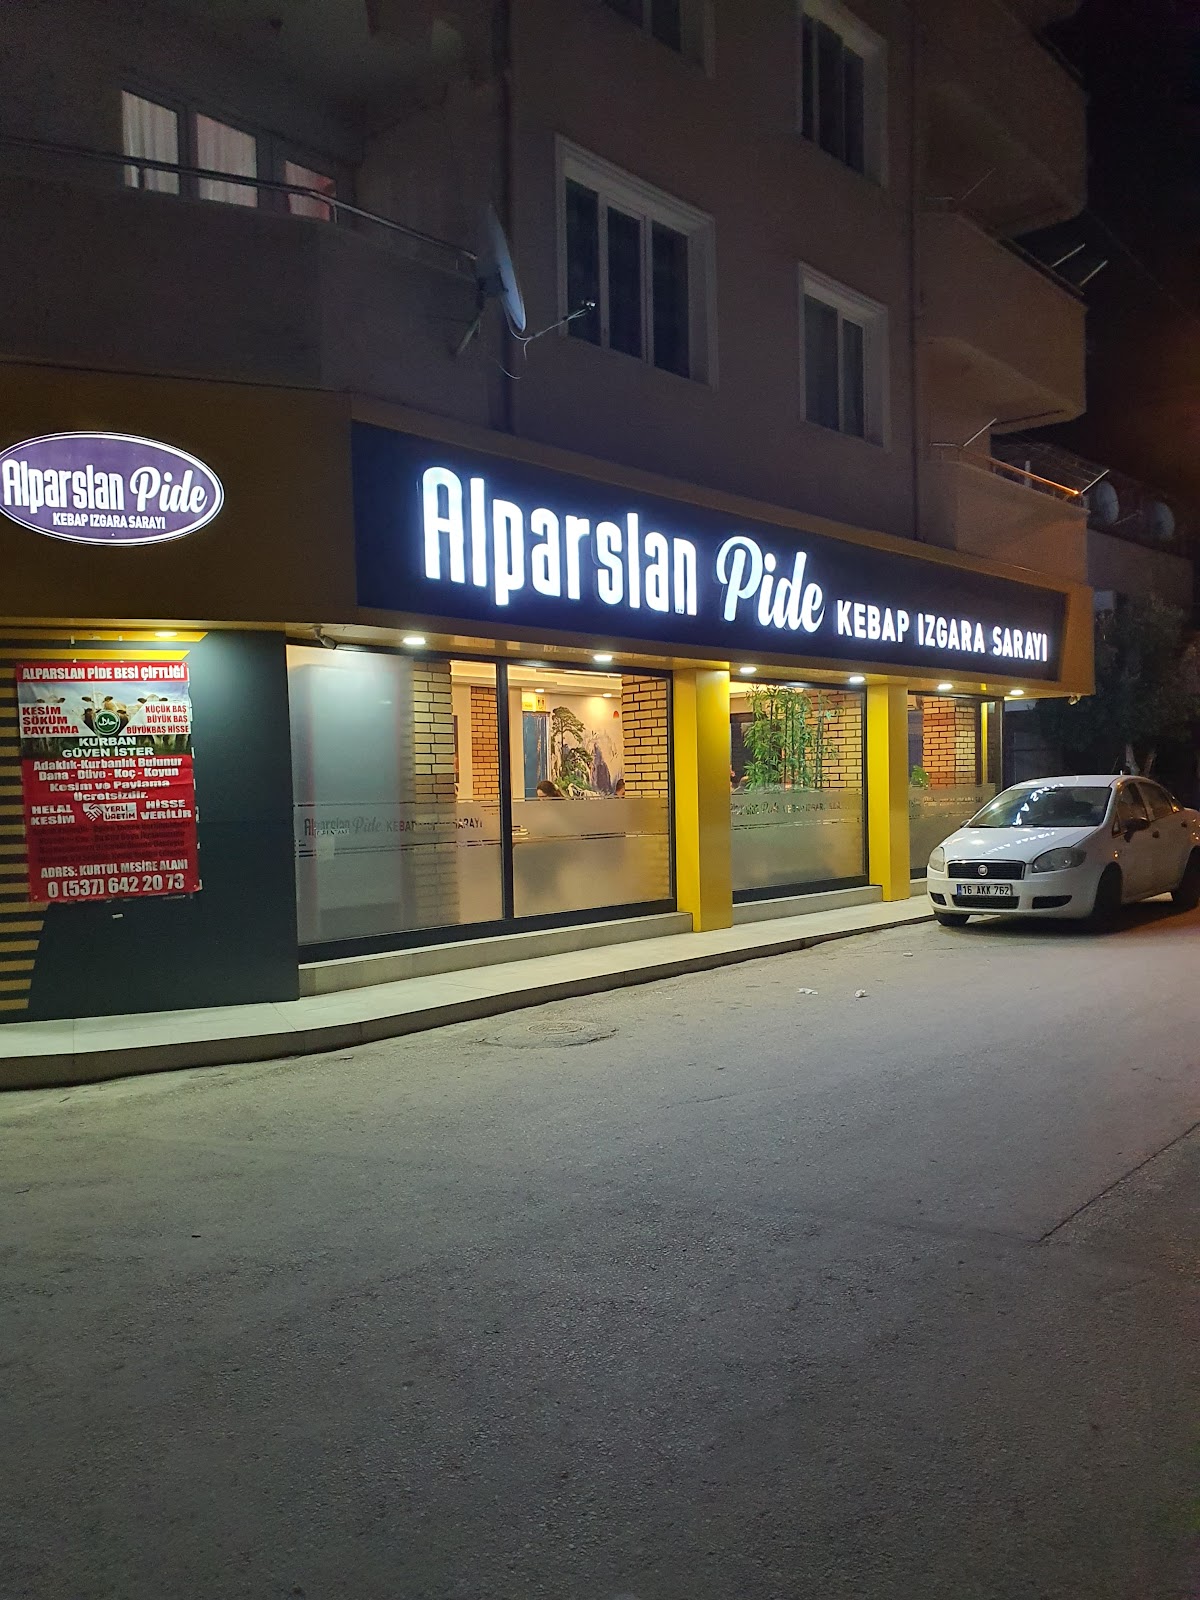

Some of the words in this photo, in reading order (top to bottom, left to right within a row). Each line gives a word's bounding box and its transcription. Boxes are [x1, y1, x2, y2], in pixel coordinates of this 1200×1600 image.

[2, 459, 125, 513] Alparslan
[130, 466, 208, 513] Pide
[53, 512, 88, 527] KEBAP
[89, 513, 128, 528] IZGARA
[129, 514, 166, 530] SARAYI
[422, 466, 698, 616] Alparslan
[716, 536, 824, 633] Pide
[837, 600, 910, 643] KEBAP
[917, 613, 985, 653] IZGARA
[992, 626, 1048, 662] SARAYI
[22, 667, 86, 680] ALPARSLAN
[87, 665, 112, 680] PİDE
[114, 665, 139, 679] BESİ
[22, 705, 61, 716] KESİM
[145, 704, 171, 715] KÜÇÜK
[22, 715, 68, 726] SÖKÜM
[147, 715, 172, 724] BÜYÜK
[23, 725, 79, 735] PAYLAMA
[167, 724, 189, 734] HİSSE
[79, 737, 137, 747] KURBAN
[62, 747, 110, 758] GÜVEN
[114, 746, 154, 757] İSTER
[138, 757, 183, 768] Bulunur
[39, 771, 69, 781] Dana
[114, 768, 136, 779] Koç
[144, 767, 179, 777] Koyun
[49, 782, 93, 792] Kesim
[94, 782, 111, 790] ve
[113, 780, 170, 789] Paylama
[31, 804, 73, 815] HELAL
[104, 804, 128, 812] YERLİ
[145, 799, 186, 809] HİSSE
[140, 809, 192, 820] VERİLİR
[30, 815, 75, 826] KESİM
[41, 867, 78, 879] ADRES:
[79, 863, 120, 877] KURTUL
[120, 860, 159, 874] MESİRE
[159, 859, 188, 872] ALANI
[47, 881, 59, 898] 0
[62, 877, 105, 897] (537)
[107, 875, 140, 894] 642
[142, 873, 163, 892] 20
[165, 872, 186, 891] 73
[963, 884, 972, 895] 16
[976, 884, 991, 895] AKK
